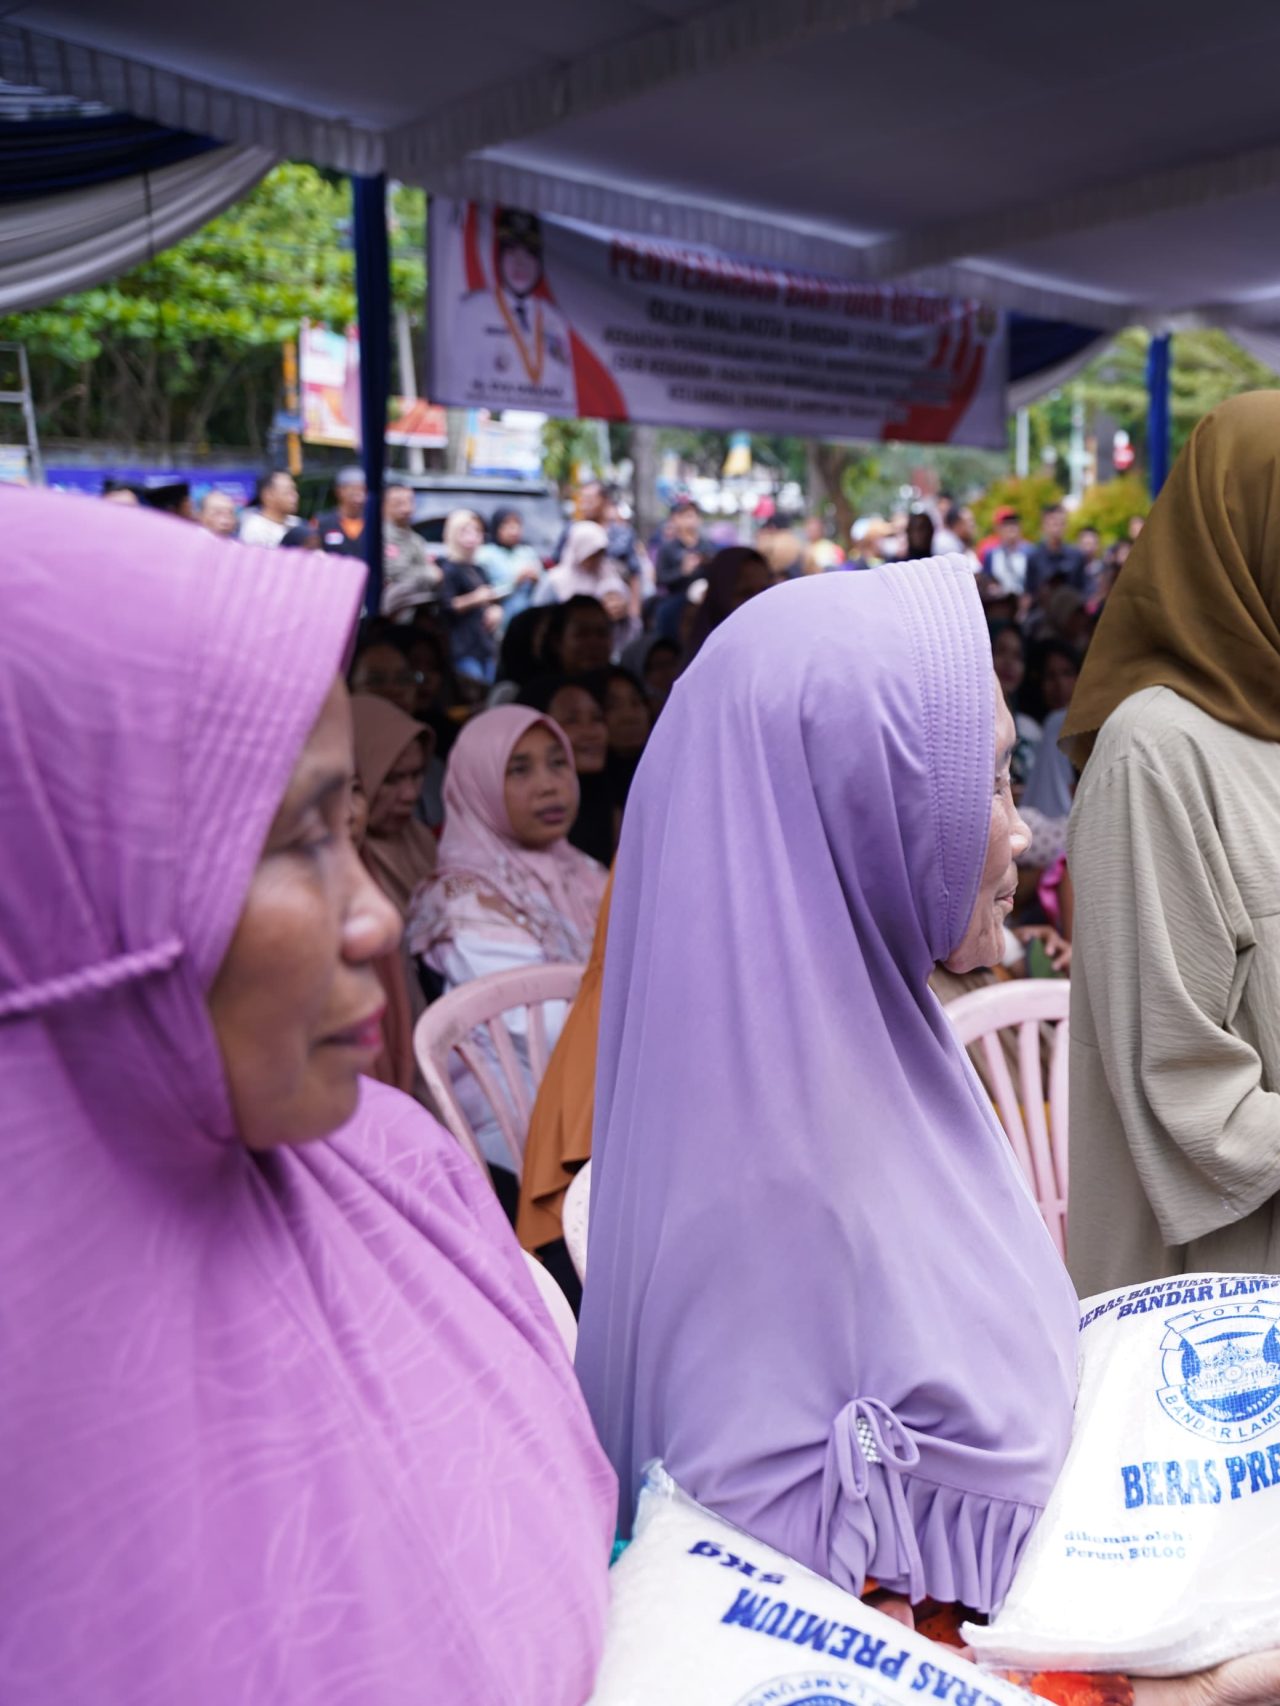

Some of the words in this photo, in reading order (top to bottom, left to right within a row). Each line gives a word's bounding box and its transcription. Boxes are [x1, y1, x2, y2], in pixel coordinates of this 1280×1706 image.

[1117, 1285, 1214, 1321] BANDAR
[1127, 1277, 1213, 1301] BANTUAN
[1193, 1305, 1261, 1322] KOTA
[1165, 1394, 1232, 1439] BANDAR
[1121, 1459, 1222, 1509] BERAS
[721, 1587, 911, 1681] PREMIUM
[910, 1662, 1004, 1706] RAS
